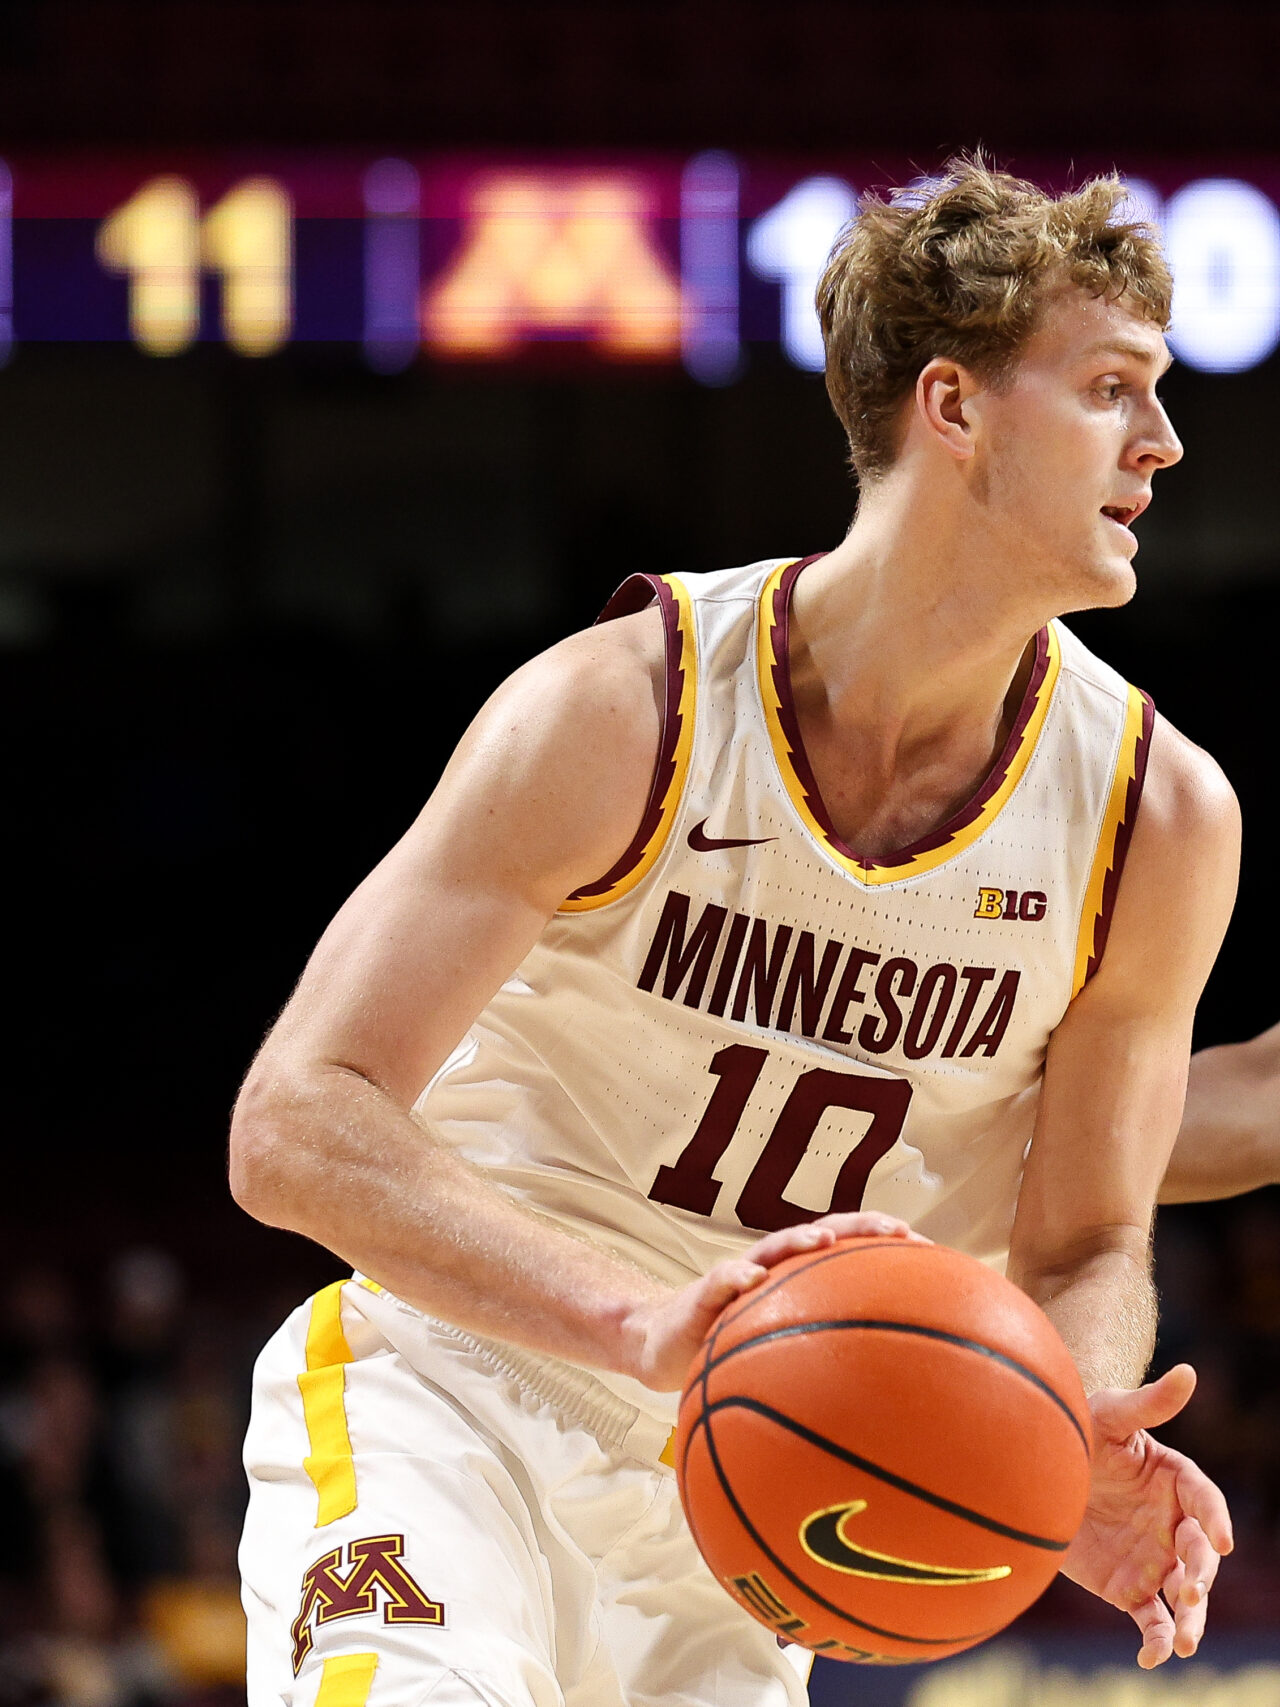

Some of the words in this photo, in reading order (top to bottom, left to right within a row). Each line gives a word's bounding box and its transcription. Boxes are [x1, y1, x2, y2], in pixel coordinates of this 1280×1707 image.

[96, 176, 293, 357] 11
[636, 890, 1021, 1060] MINNESOTA
[647, 1043, 914, 1232] 10
[292, 1534, 446, 1679] M
